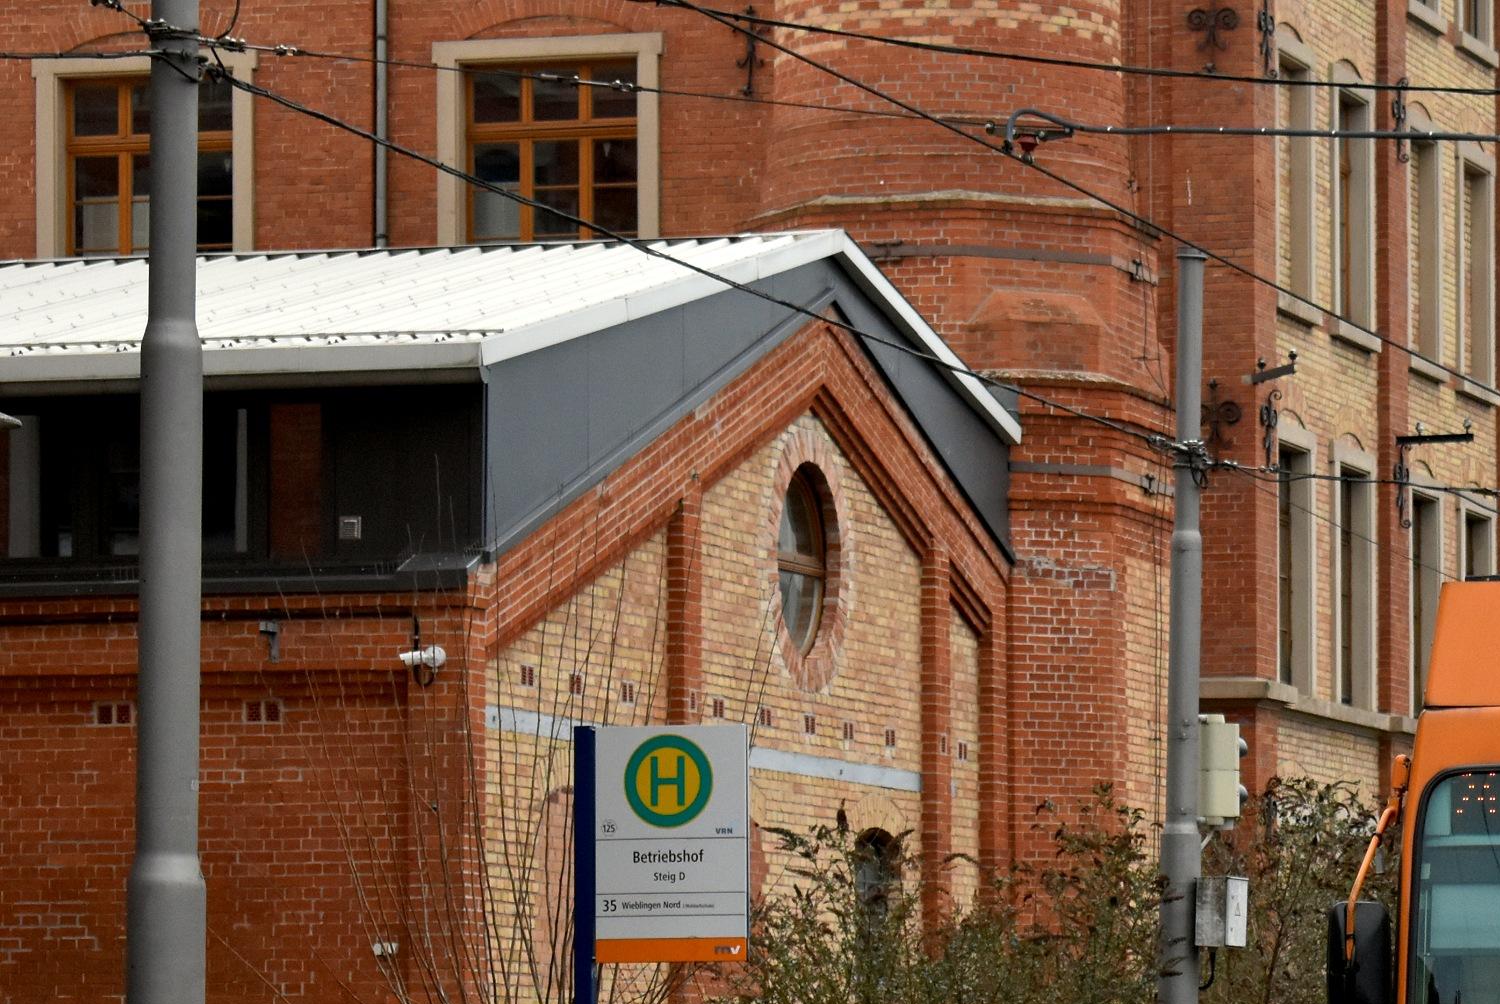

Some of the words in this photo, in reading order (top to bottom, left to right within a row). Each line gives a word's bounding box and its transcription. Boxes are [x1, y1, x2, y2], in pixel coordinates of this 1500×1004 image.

[650, 755, 686, 807] H
[602, 824, 616, 833] 125
[715, 827, 733, 835] VRN
[632, 849, 704, 864] Betriebshof
[653, 871, 676, 883] Steig
[679, 871, 686, 881] D
[602, 899, 617, 912] 35
[621, 901, 661, 911] Wieblingen
[663, 900, 681, 909] Nord
